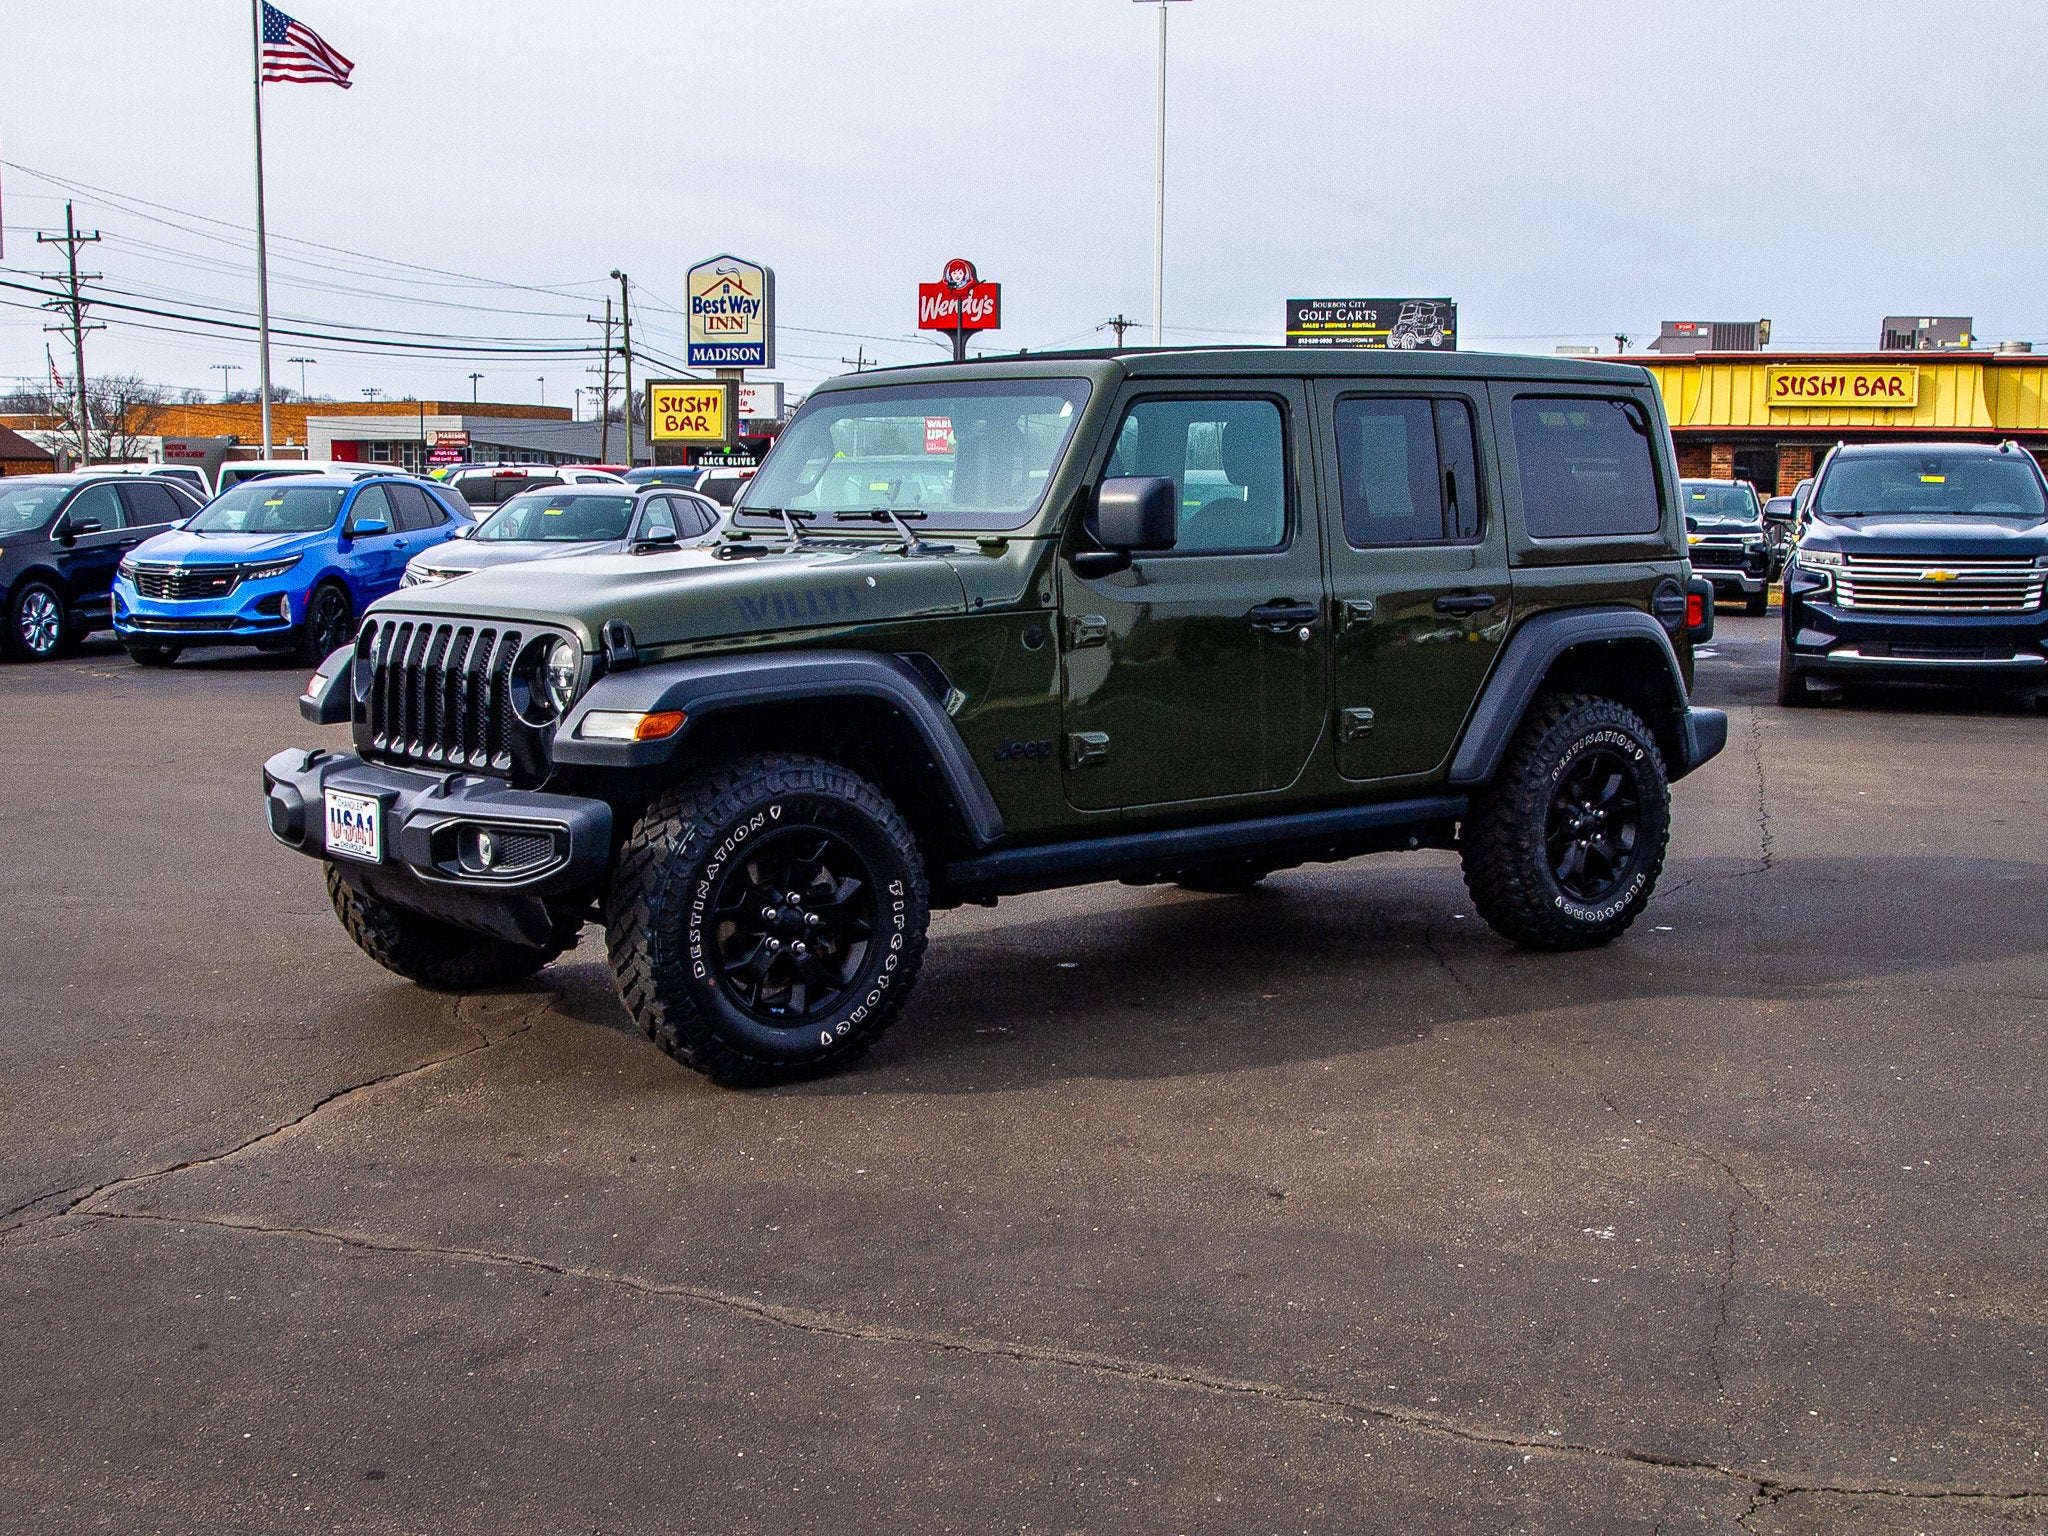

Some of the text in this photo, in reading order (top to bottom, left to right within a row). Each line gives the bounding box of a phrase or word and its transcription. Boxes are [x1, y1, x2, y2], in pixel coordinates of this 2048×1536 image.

[692, 295, 761, 320] Best Way
[921, 289, 994, 323] Wendy's
[1312, 300, 1367, 309] BOURBON CITY
[708, 316, 744, 330] INN
[1298, 309, 1377, 321] GOLF CARTS
[692, 347, 761, 361] MADISON
[1776, 376, 1906, 397] SUSHI BAR
[658, 396, 719, 432] SUSHI BAR
[698, 456, 757, 466] BLACK OLIVES
[690, 813, 765, 979] DESTINATION
